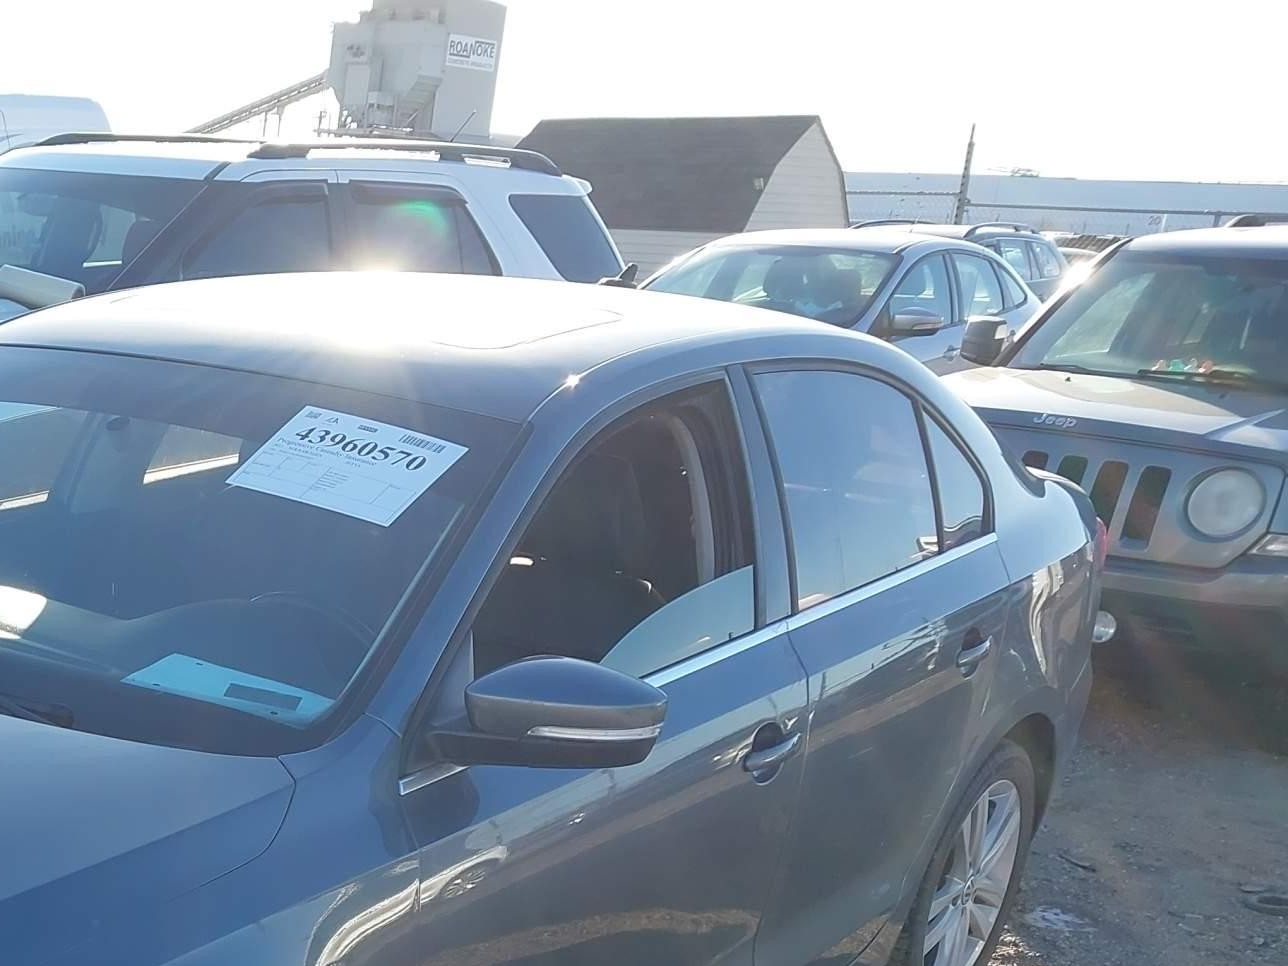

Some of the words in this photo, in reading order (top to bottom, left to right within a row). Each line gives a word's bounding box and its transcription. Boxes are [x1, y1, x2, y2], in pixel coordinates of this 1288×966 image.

[448, 39, 496, 59] ROANOKE
[1032, 413, 1077, 428] Jeep
[295, 426, 427, 471] 43960570
